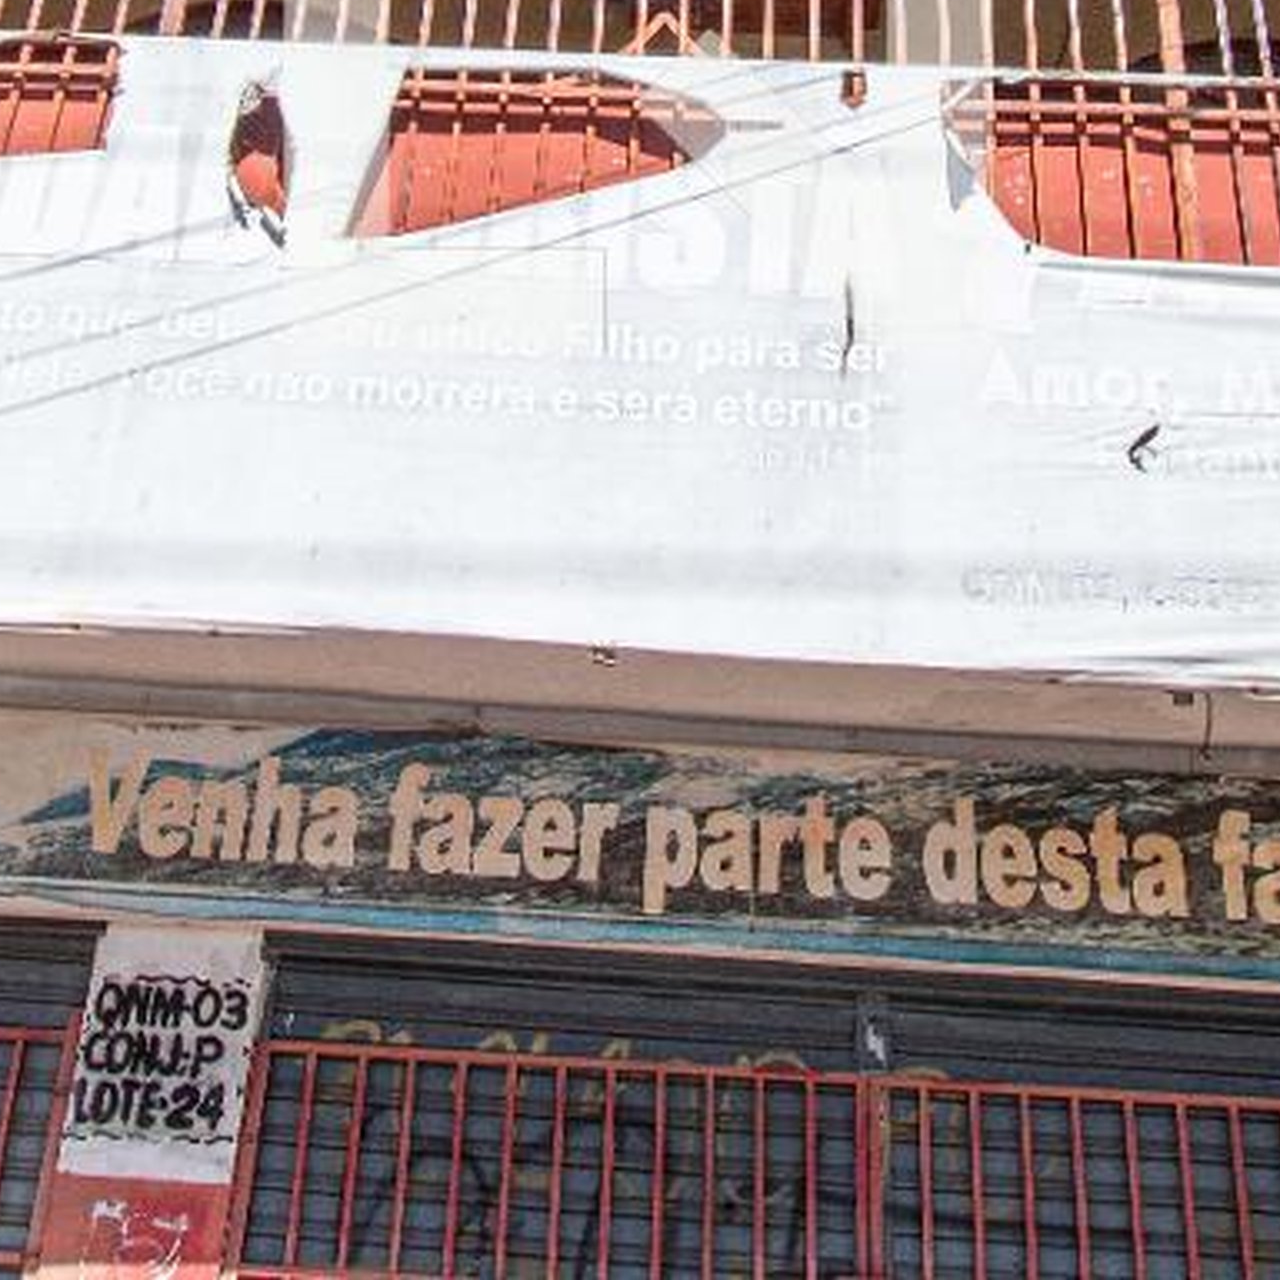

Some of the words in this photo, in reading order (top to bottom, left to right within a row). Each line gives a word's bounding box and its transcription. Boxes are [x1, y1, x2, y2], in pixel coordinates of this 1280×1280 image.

[694, 331, 801, 374] para
[554, 386, 582, 418] e
[594, 382, 699, 424] será
[85, 744, 359, 870] Venha
[387, 761, 619, 884] fazer
[641, 793, 893, 915] parte
[922, 797, 1188, 919] desta
